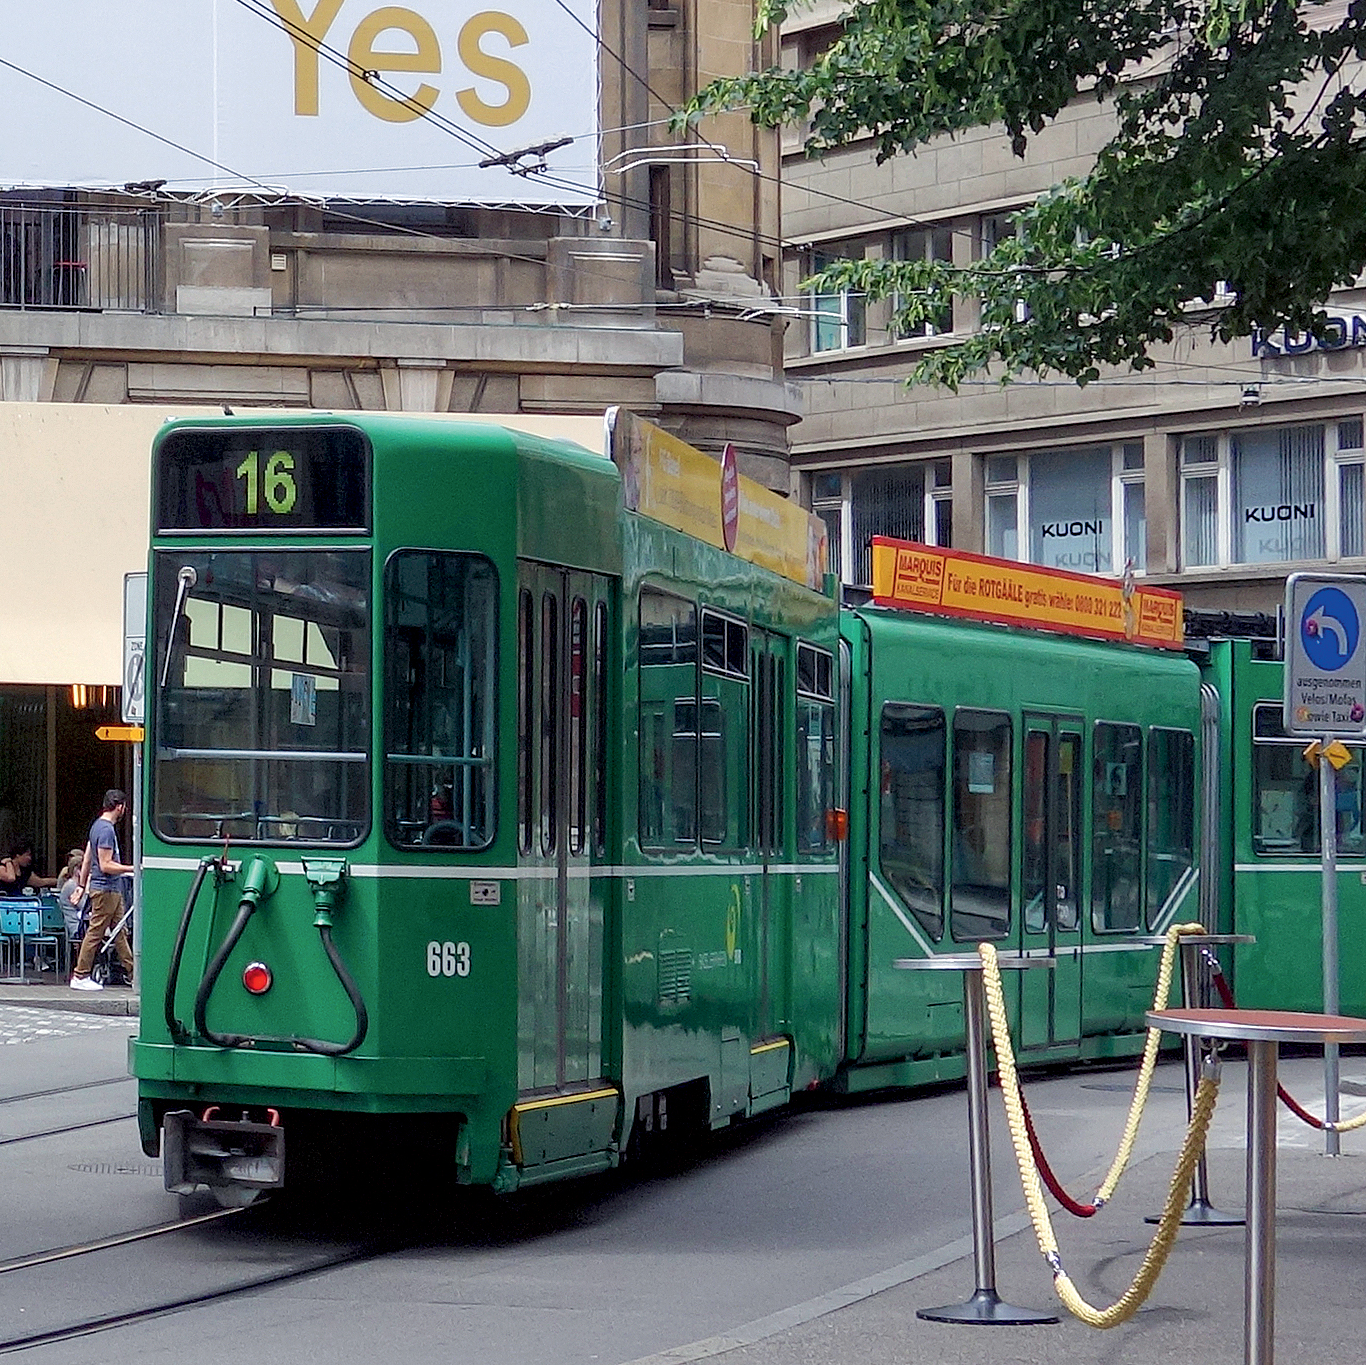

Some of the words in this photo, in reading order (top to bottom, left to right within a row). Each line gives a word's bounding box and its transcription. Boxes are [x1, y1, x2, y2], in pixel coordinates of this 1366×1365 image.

[236, 450, 297, 514] 16
[1246, 503, 1315, 523] KUONI
[1041, 521, 1103, 538] KUONI
[899, 554, 942, 581] MARQUIS
[948, 572, 962, 594] Für
[964, 576, 977, 595] die
[1094, 597, 1107, 617] 321
[1296, 677, 1362, 691] ausgenommen
[1301, 692, 1357, 707] Velos/Mofas
[1306, 711, 1330, 723] owie
[426, 941, 473, 978] 663
